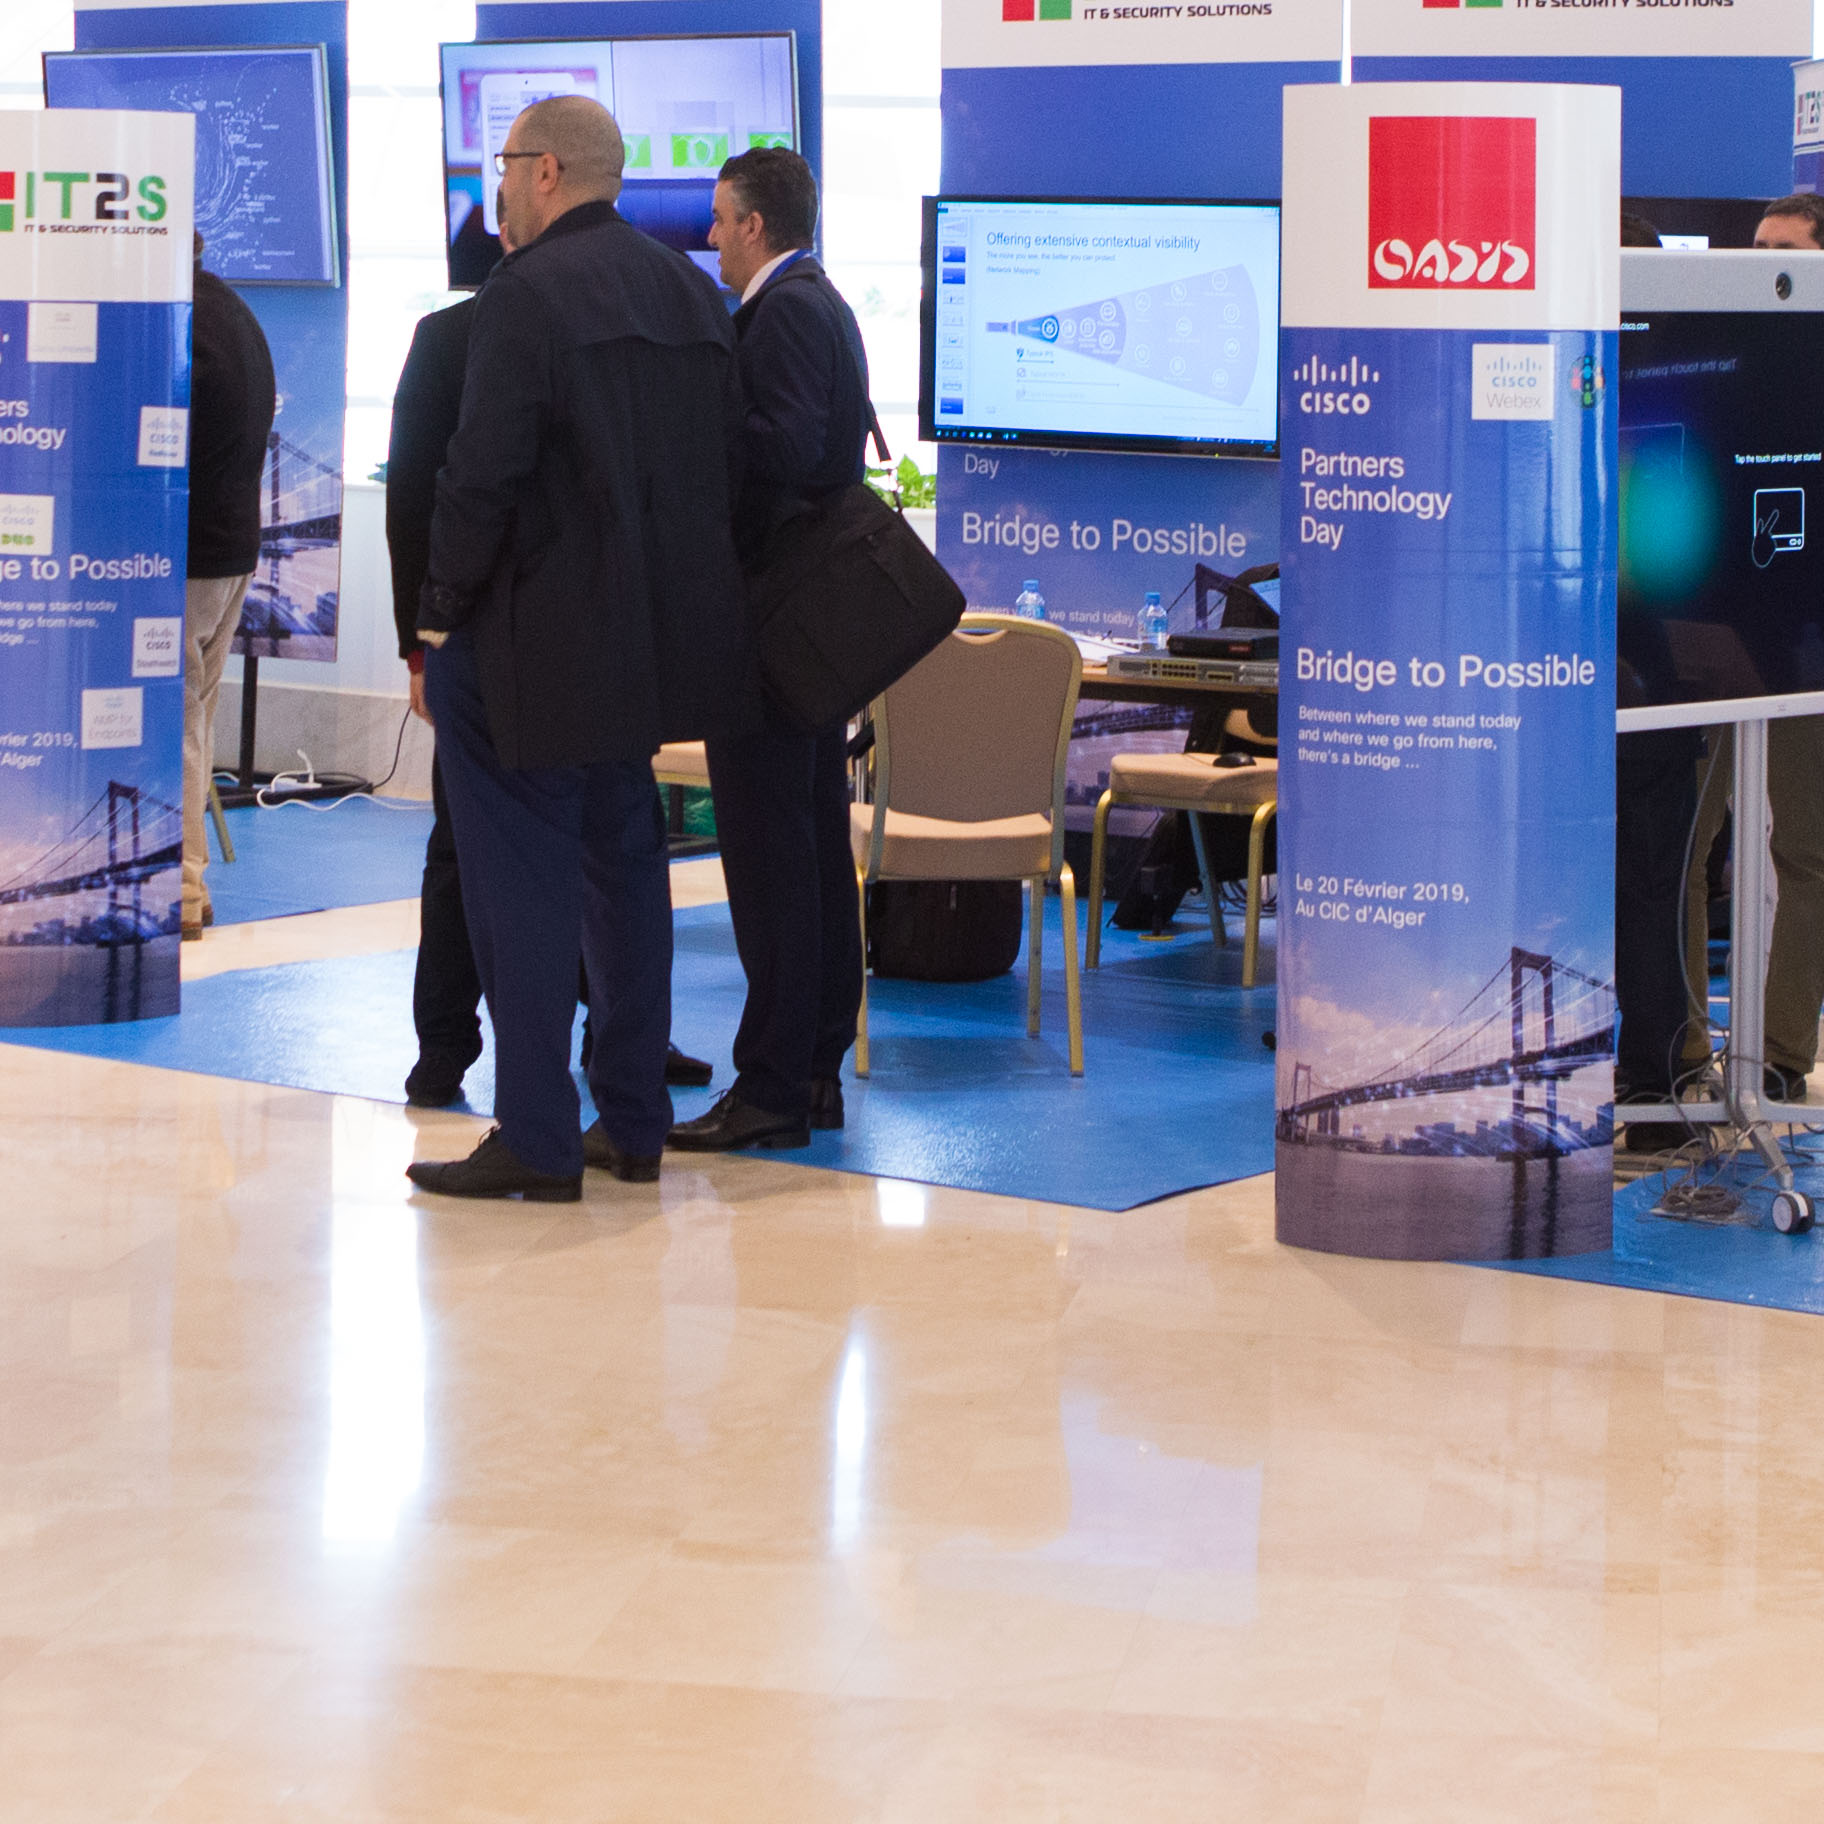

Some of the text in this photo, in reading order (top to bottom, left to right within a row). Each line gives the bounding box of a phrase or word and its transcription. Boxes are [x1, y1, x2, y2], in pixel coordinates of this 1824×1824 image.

[1084, 3, 1273, 20] IT & SECURITY SOLUTIONS
[25, 171, 168, 222] IT2S
[50, 225, 108, 234] SECURITY
[111, 226, 168, 236] SOLUTIONS
[986, 232, 1201, 252] Offering extensive contextual visibility
[1486, 392, 1543, 409] Webex
[963, 452, 1001, 479] Day
[1300, 447, 1405, 479] Partners
[1299, 481, 1452, 521] Technology
[961, 511, 1247, 558] Bridge to Possible
[1300, 515, 1344, 551] Day
[30, 555, 60, 581] to
[69, 552, 172, 581] Possible
[26, 602, 46, 612] we
[48, 600, 83, 613] stand
[85, 600, 118, 614] today
[1049, 611, 1066, 621] we
[1069, 608, 1101, 624] stand
[1102, 610, 1135, 626] today
[18, 618, 34, 631] go
[36, 616, 66, 629] from
[1297, 647, 1596, 693] Bridge to Possible
[1298, 705, 1522, 731] Between where we stand today
[32, 732, 79, 749] 2019,
[1298, 727, 1498, 751] and where we go from here,
[1297, 746, 1339, 764] there's
[1353, 751, 1401, 770] bridge
[1295, 872, 1470, 904] Le 20 Février 2019,
[1294, 898, 1427, 930] Au CIC d'Alger
